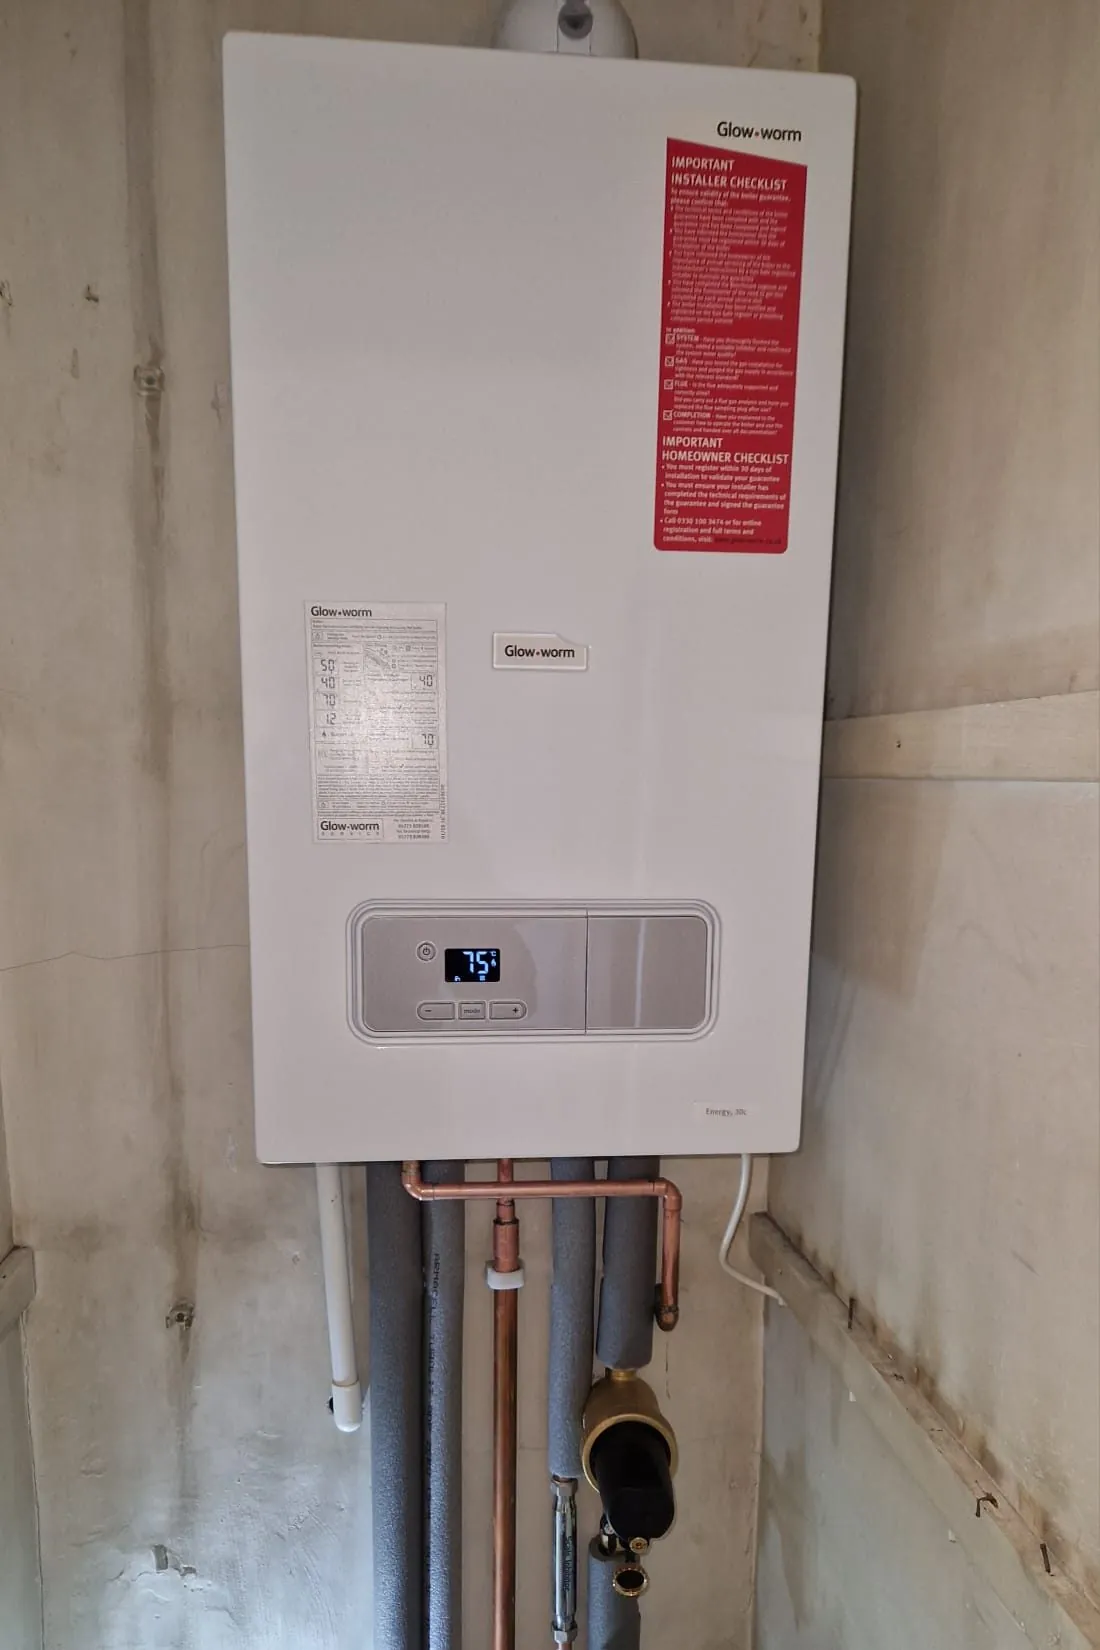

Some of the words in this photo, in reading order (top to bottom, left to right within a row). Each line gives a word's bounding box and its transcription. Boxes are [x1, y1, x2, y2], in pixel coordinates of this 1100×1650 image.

[672, 156, 735, 172] IMPORTANT
[672, 172, 727, 187] INSTALLER
[730, 176, 787, 191] CHECKLIST
[662, 436, 724, 448] IMPORTANT
[662, 450, 731, 462] HOMEOWNER
[734, 452, 790, 464] CHECKLIST
[696, 464, 719, 472] register
[731, 482, 756, 490] installer
[664, 490, 696, 499] completed
[708, 491, 738, 499] technical
[738, 493, 778, 501] requirements
[676, 500, 706, 508] guarantee
[462, 951, 489, 974] 75
